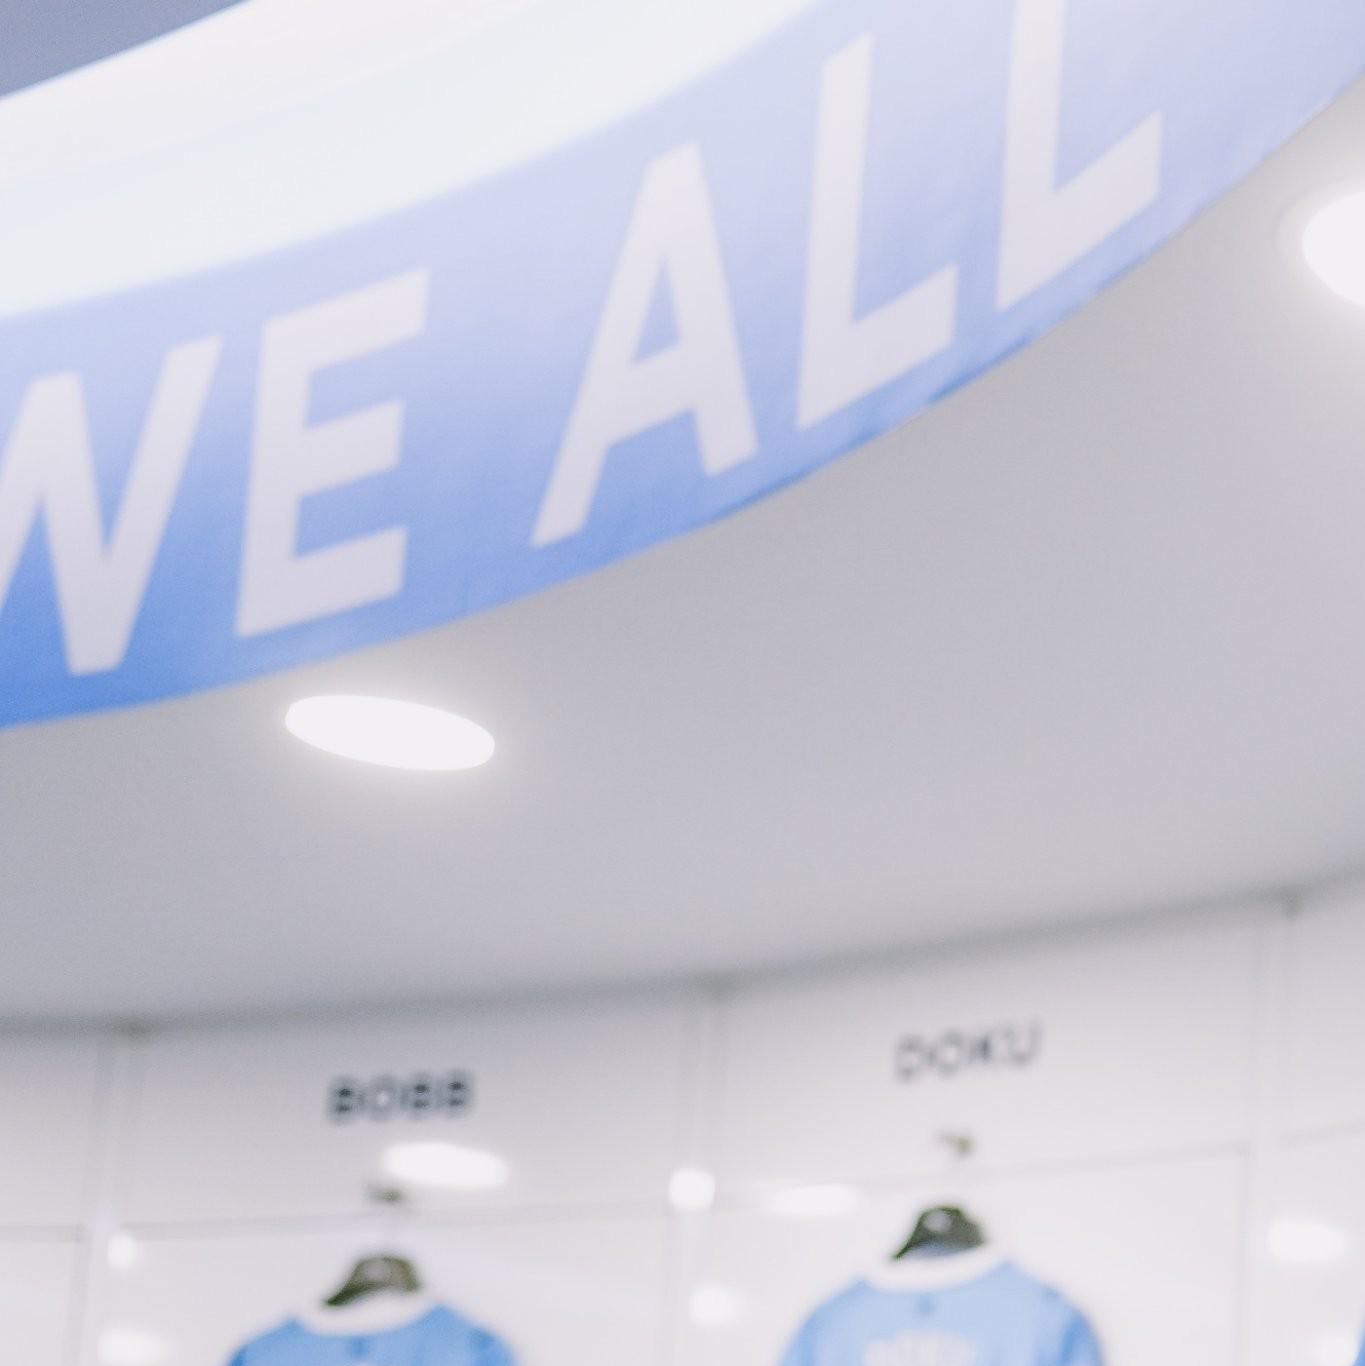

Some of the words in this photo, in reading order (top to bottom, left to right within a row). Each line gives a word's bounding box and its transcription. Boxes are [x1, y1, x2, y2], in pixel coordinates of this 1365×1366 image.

[0, 266, 431, 677] WE
[530, 0, 1163, 549] ALL
[895, 1023, 1043, 1081] DOKU
[329, 1072, 472, 1123] BOBB
